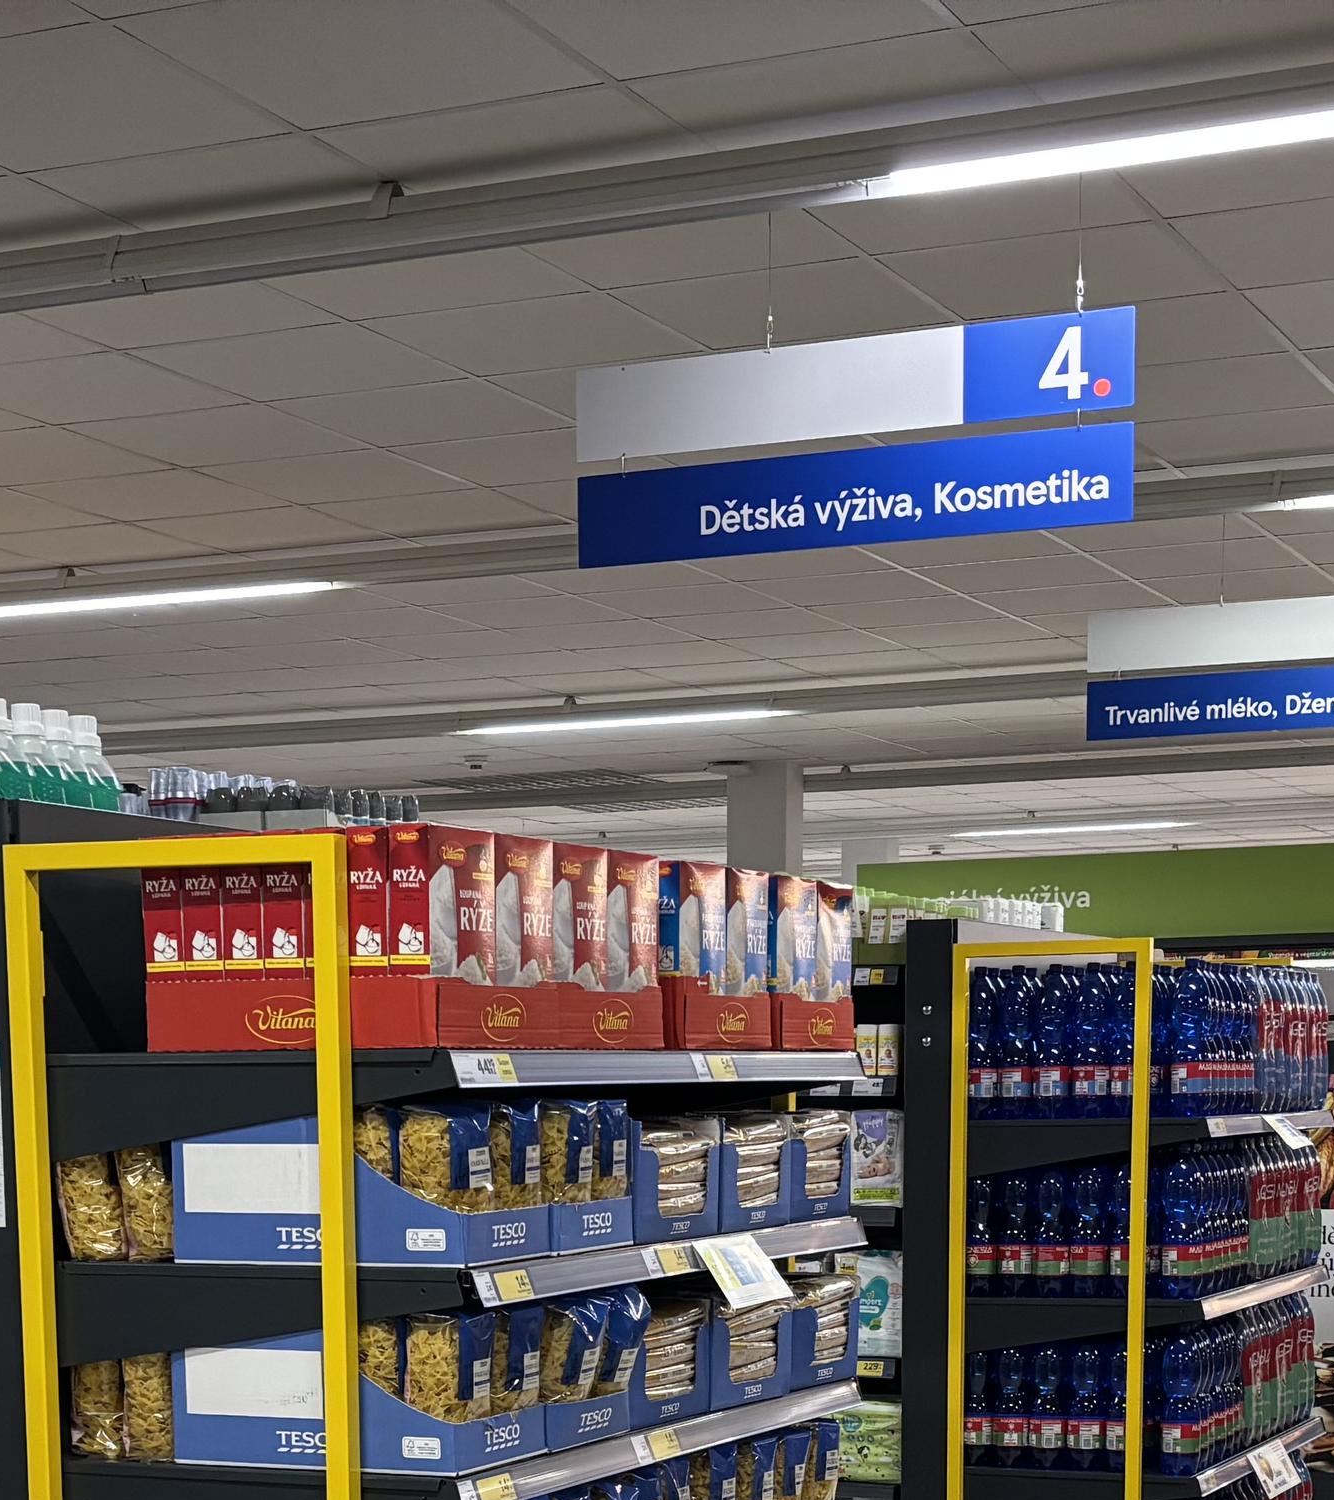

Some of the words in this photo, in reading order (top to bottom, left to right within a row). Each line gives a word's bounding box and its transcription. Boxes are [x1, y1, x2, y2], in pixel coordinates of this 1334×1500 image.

[699, 497, 805, 536] Dětská
[813, 486, 923, 533] výživa,
[934, 469, 1110, 515] Kosmetika
[1105, 699, 1200, 727] Trvanlivé
[1205, 694, 1278, 722] mléko,
[145, 875, 177, 895] RYŽA
[185, 874, 216, 892] RYŽA
[225, 873, 257, 890] RYŽA
[267, 872, 298, 888] RYŽA
[461, 904, 494, 933] RÝŽE
[523, 910, 552, 938] RÝŽE
[577, 911, 606, 943] RÝŽE
[631, 916, 657, 946] RÝŽE
[253, 1006, 315, 1031] Vitana
[486, 1005, 521, 1031] Vitana
[598, 1008, 629, 1033] Vitana
[721, 1011, 747, 1034] Vitana
[750, 1211, 766, 1221] TESCO
[814, 1203, 828, 1214] TESCO
[492, 1222, 526, 1240] TESCO
[582, 1212, 612, 1230] TESCO
[671, 1220, 690, 1231] TESCO
[580, 1407, 612, 1427] TESCO
[485, 1425, 520, 1445] TESCO
